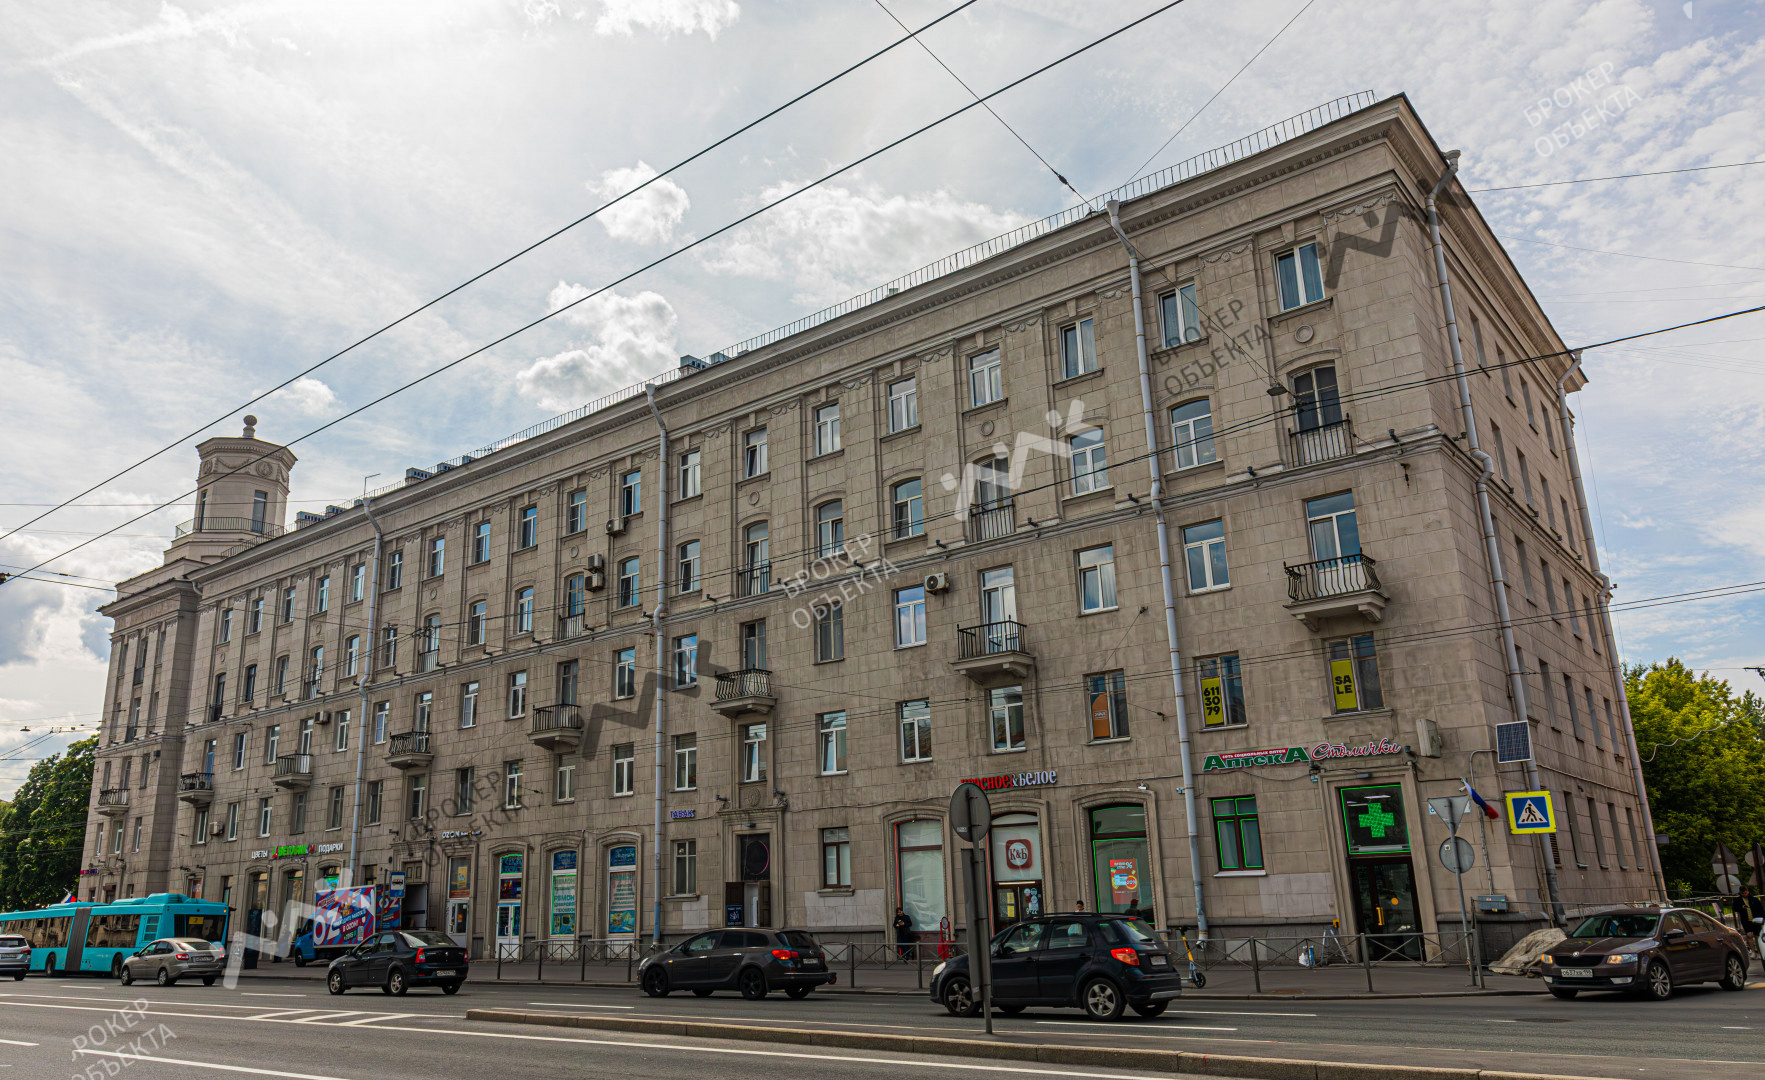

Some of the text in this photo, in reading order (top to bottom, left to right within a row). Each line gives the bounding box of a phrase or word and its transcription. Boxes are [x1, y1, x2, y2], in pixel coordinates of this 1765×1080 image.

[1203, 686, 1220, 697] 611
[1205, 697, 1220, 706] 30
[1207, 706, 1220, 716] 79
[669, 809, 695, 819] ТАБАК
[442, 830, 461, 839] OZON
[251, 850, 269, 859] ЦВЕТЫ
[318, 843, 344, 854] ПОДАРКИ
